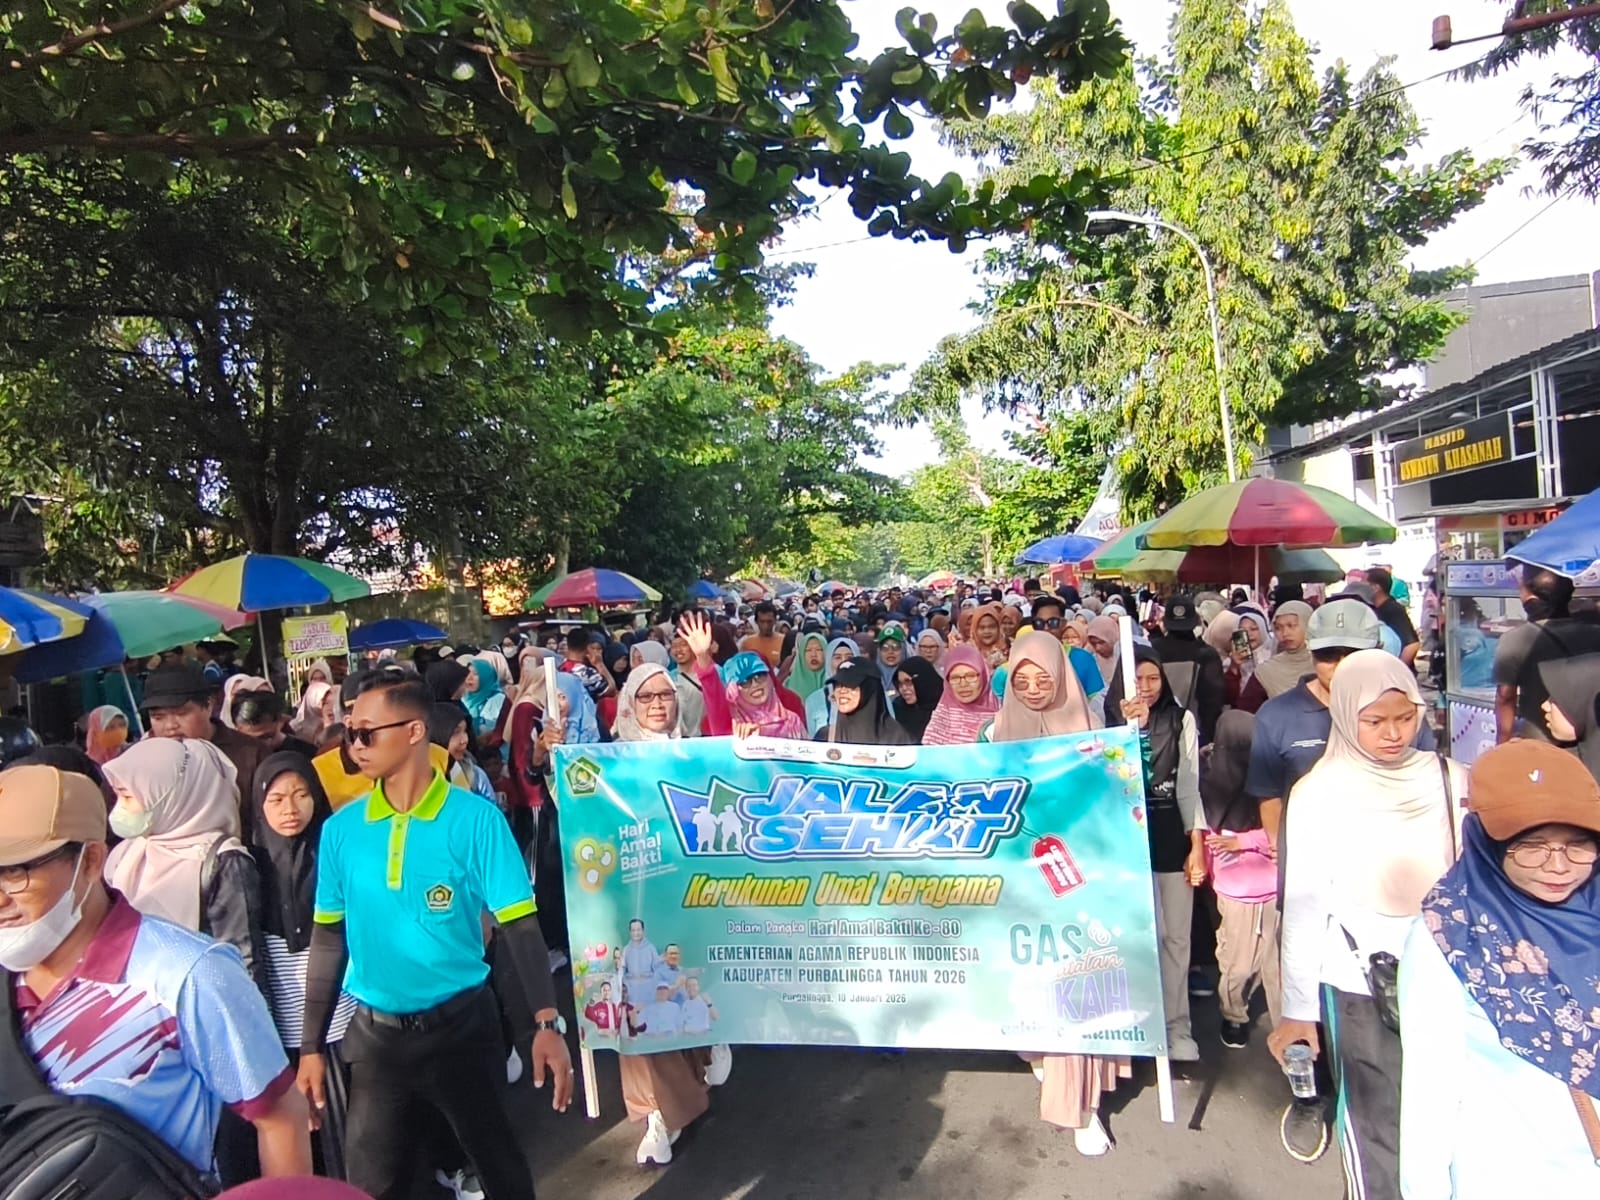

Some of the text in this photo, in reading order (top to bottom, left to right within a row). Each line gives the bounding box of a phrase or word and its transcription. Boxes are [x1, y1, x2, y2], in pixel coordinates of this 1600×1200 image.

[1424, 428, 1465, 450] MASJID
[741, 777, 1026, 817] JALAN
[618, 818, 650, 841] Hari
[748, 815, 1014, 857] SEHAT
[620, 831, 662, 855] Amal
[620, 847, 662, 871] Bakti
[683, 873, 1003, 907] Kerukunan Umat Beragama
[727, 920, 761, 934] Dalam
[766, 920, 805, 937] Rangka
[708, 947, 979, 962] KEMENTERIAN AGAMA REPUBLIK INDONESIA
[723, 968, 966, 984] KABUPATEN PURBALINGGA TAHUN 2026
[886, 994, 906, 1004] 2026
